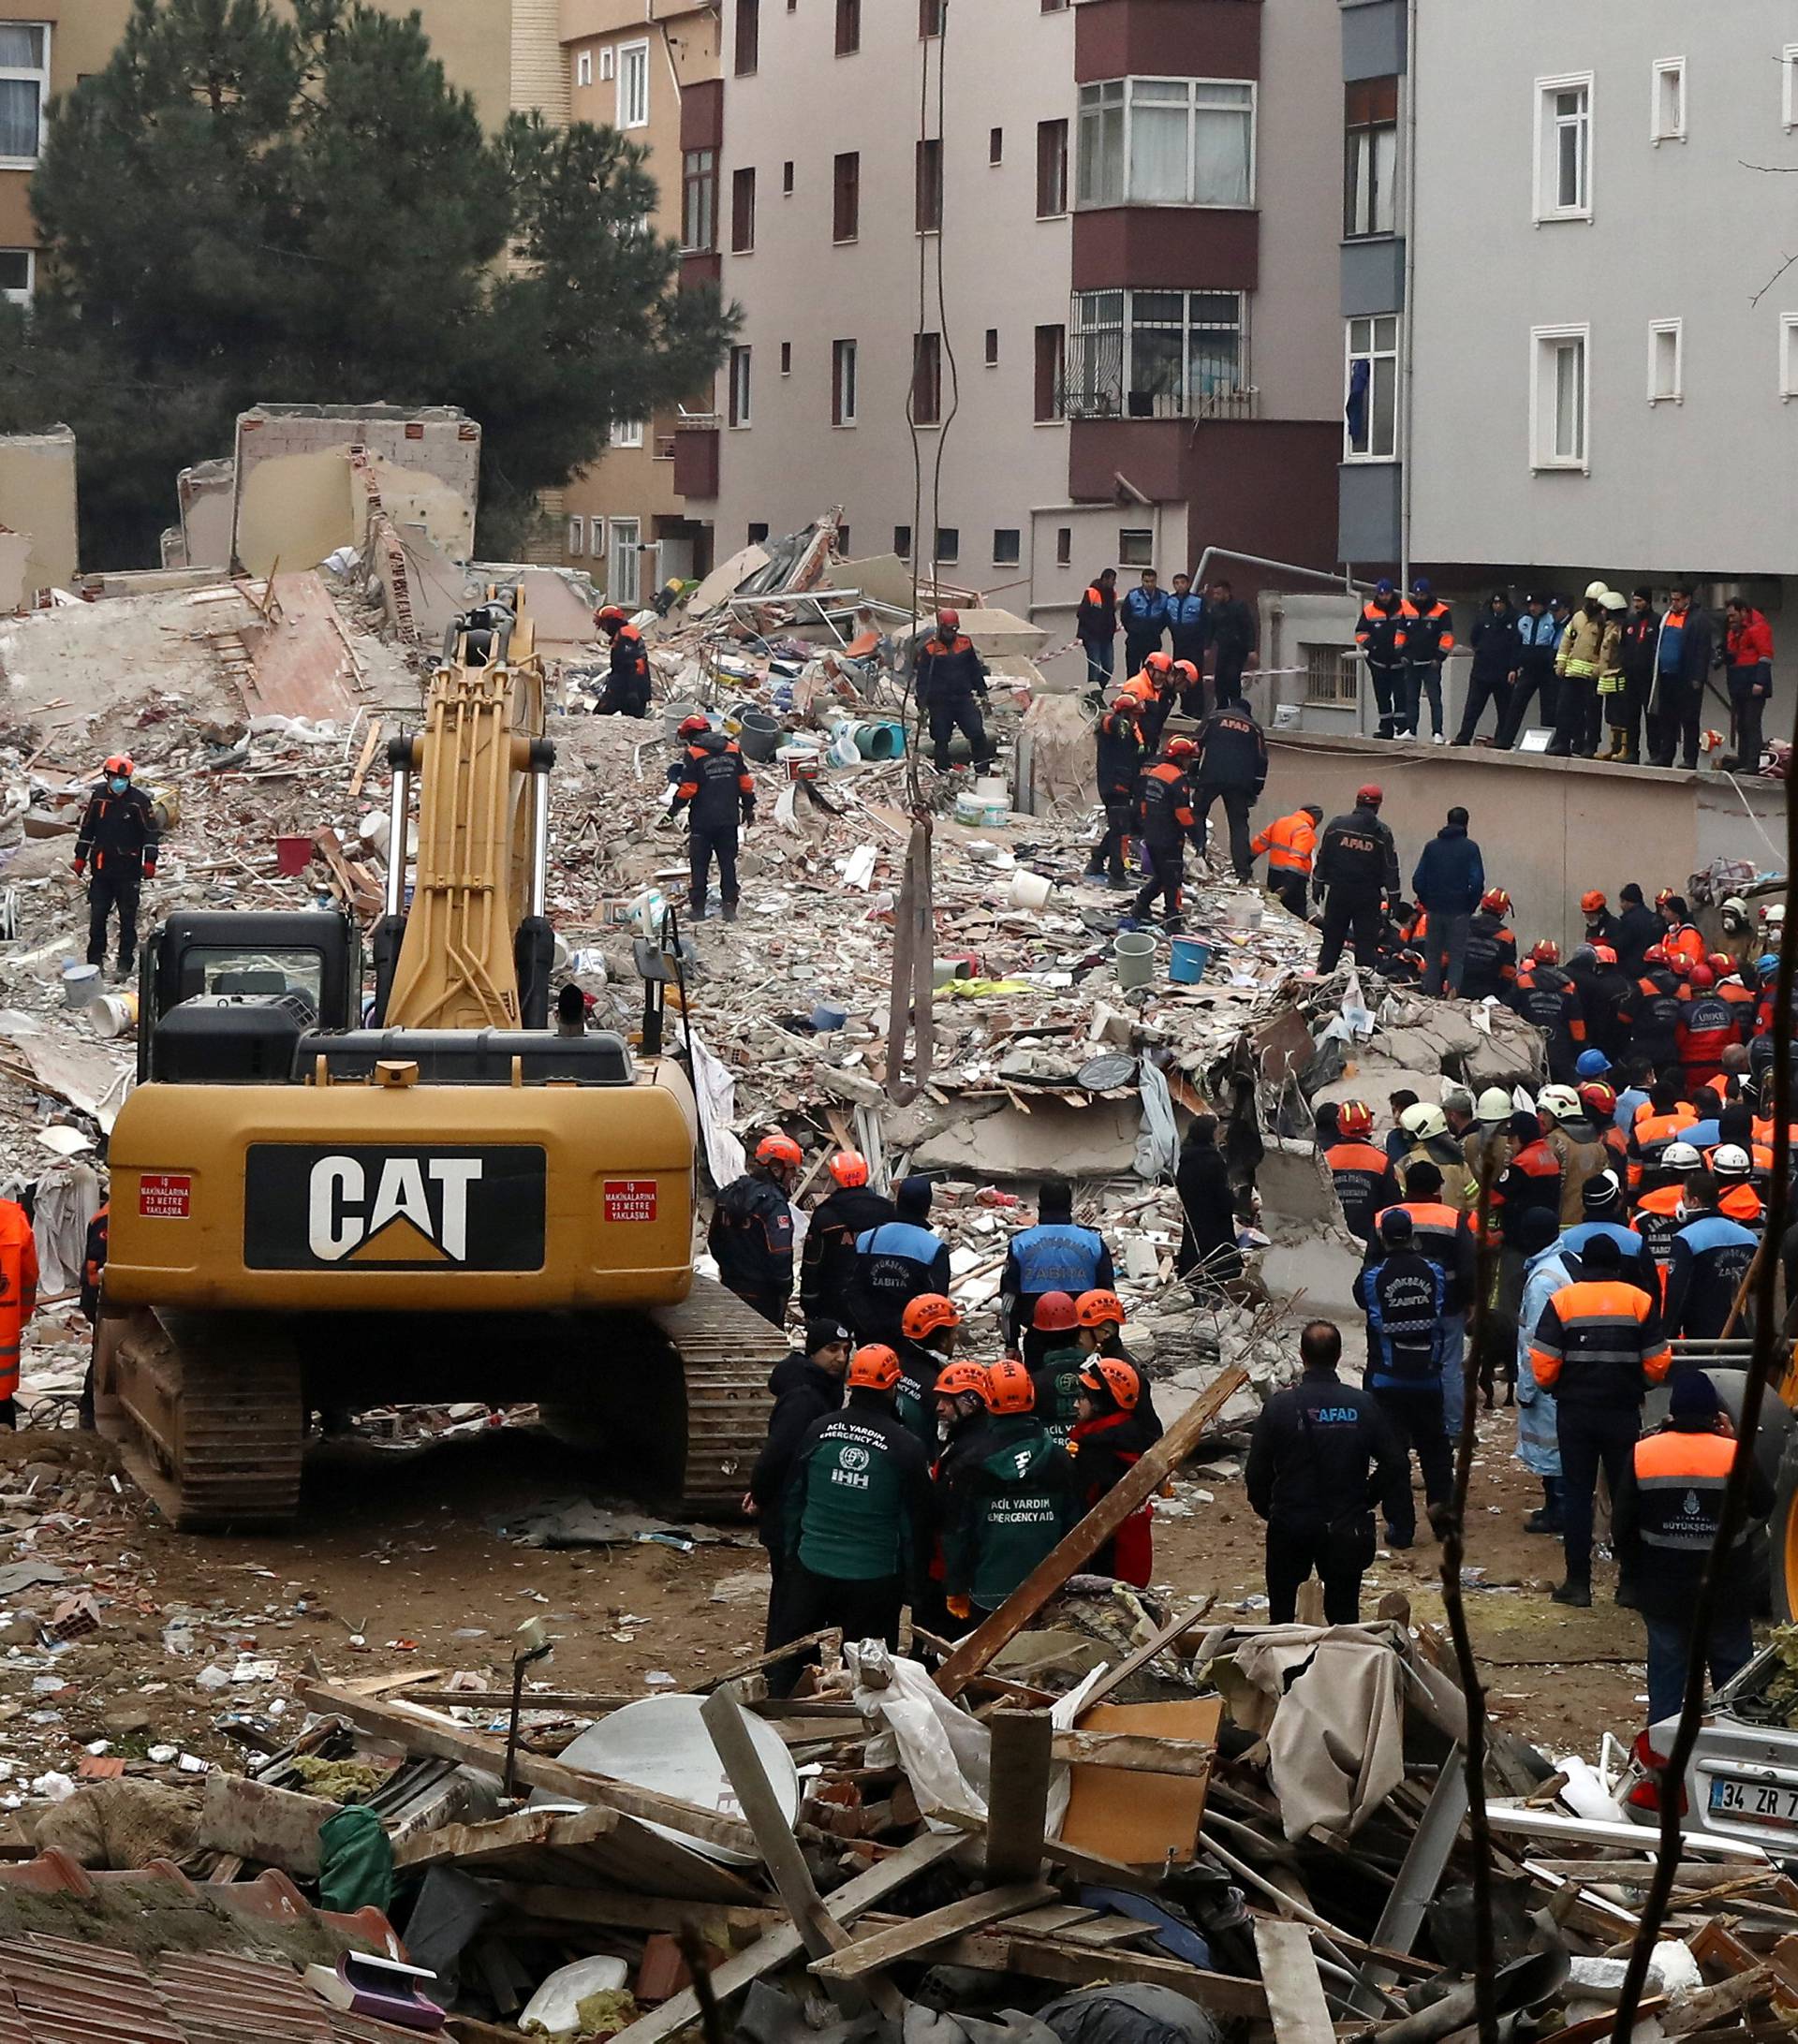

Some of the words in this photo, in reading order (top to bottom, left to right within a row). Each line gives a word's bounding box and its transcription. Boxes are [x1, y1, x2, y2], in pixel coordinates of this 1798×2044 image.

[1219, 719, 1250, 733] AFAD
[1340, 836, 1374, 851] AFAD
[1698, 1011, 1726, 1022] UMKE
[146, 1197, 155, 1205] 25
[157, 1198, 183, 1206] METRE
[309, 1155, 482, 1261] CAT
[612, 1202, 621, 1211] 25
[624, 1202, 650, 1211] METRE
[146, 1207, 182, 1216] YAKLAŞMA
[612, 1212, 650, 1221] YAKLAŞMA
[873, 1277, 907, 1287] ZABITA
[1388, 1295, 1430, 1308] ZABITA
[907, 1390, 921, 1401] AID
[1319, 1407, 1358, 1422] AFAD
[827, 1421, 847, 1432] ACİL
[849, 1424, 886, 1442] YARDIM
[819, 1431, 873, 1444] EMERGENCY
[872, 1440, 889, 1450] AID
[991, 1498, 1011, 1510] ACİL
[1012, 1498, 1051, 1509] YARDIM
[987, 1512, 1039, 1523] EMERGENCY
[1039, 1510, 1054, 1522] AID
[1723, 1784, 1744, 1809] 34
[1756, 1787, 1778, 1815] ZR
